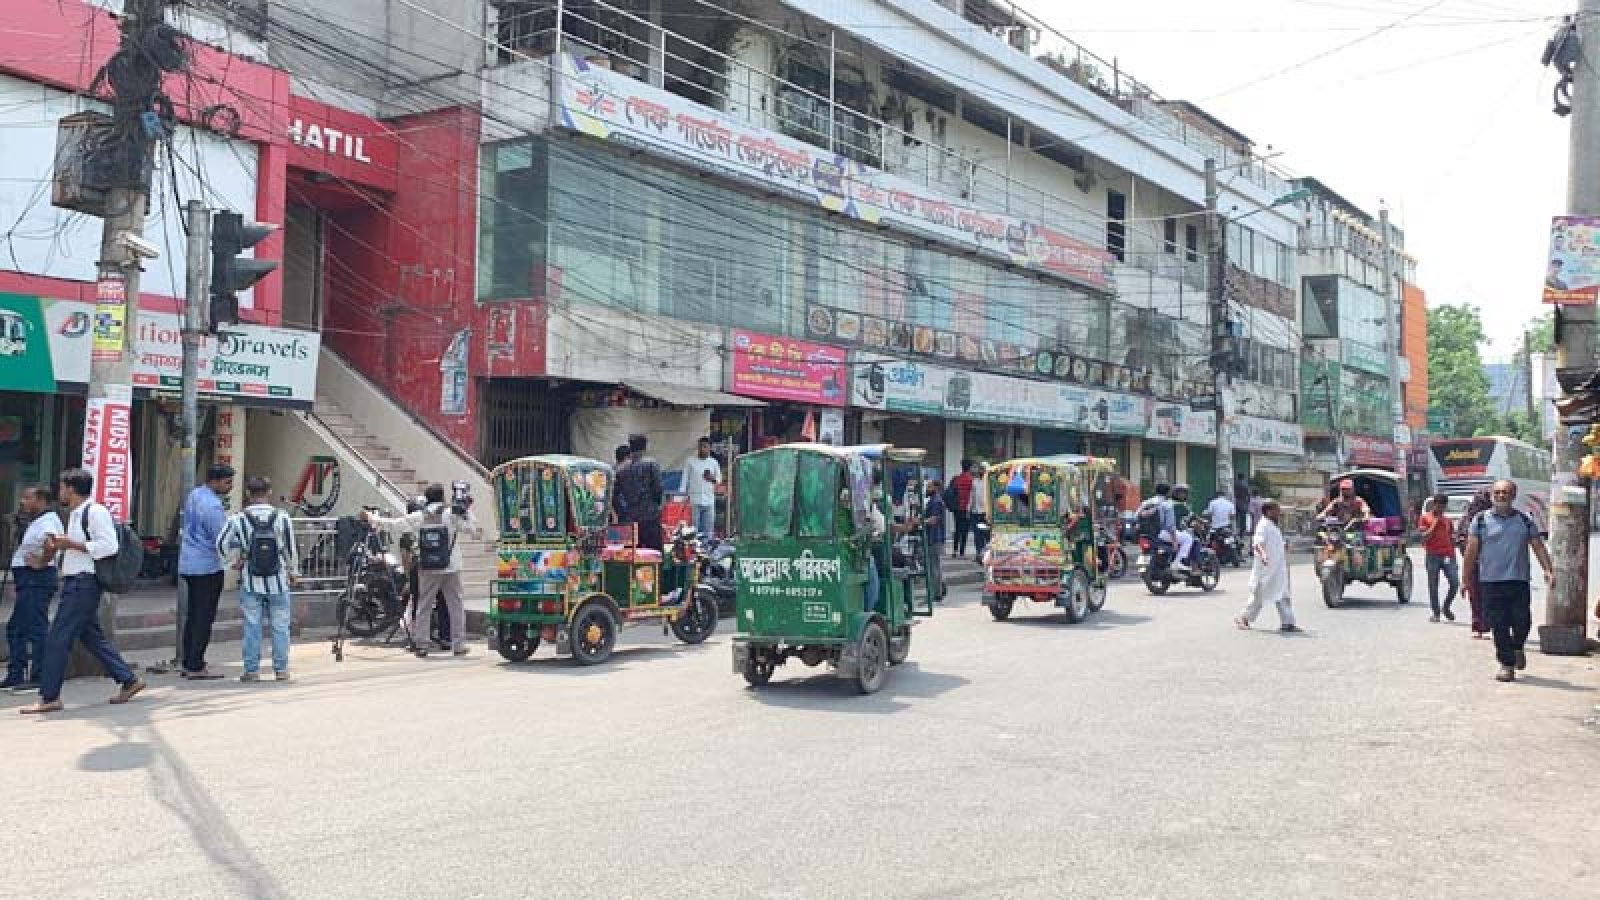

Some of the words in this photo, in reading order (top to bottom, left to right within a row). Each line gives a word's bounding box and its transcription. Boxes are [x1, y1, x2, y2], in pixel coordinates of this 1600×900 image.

[219, 332, 309, 360] Travels
[109, 409, 128, 449] KIDS
[104, 452, 126, 519] ENGLIS
